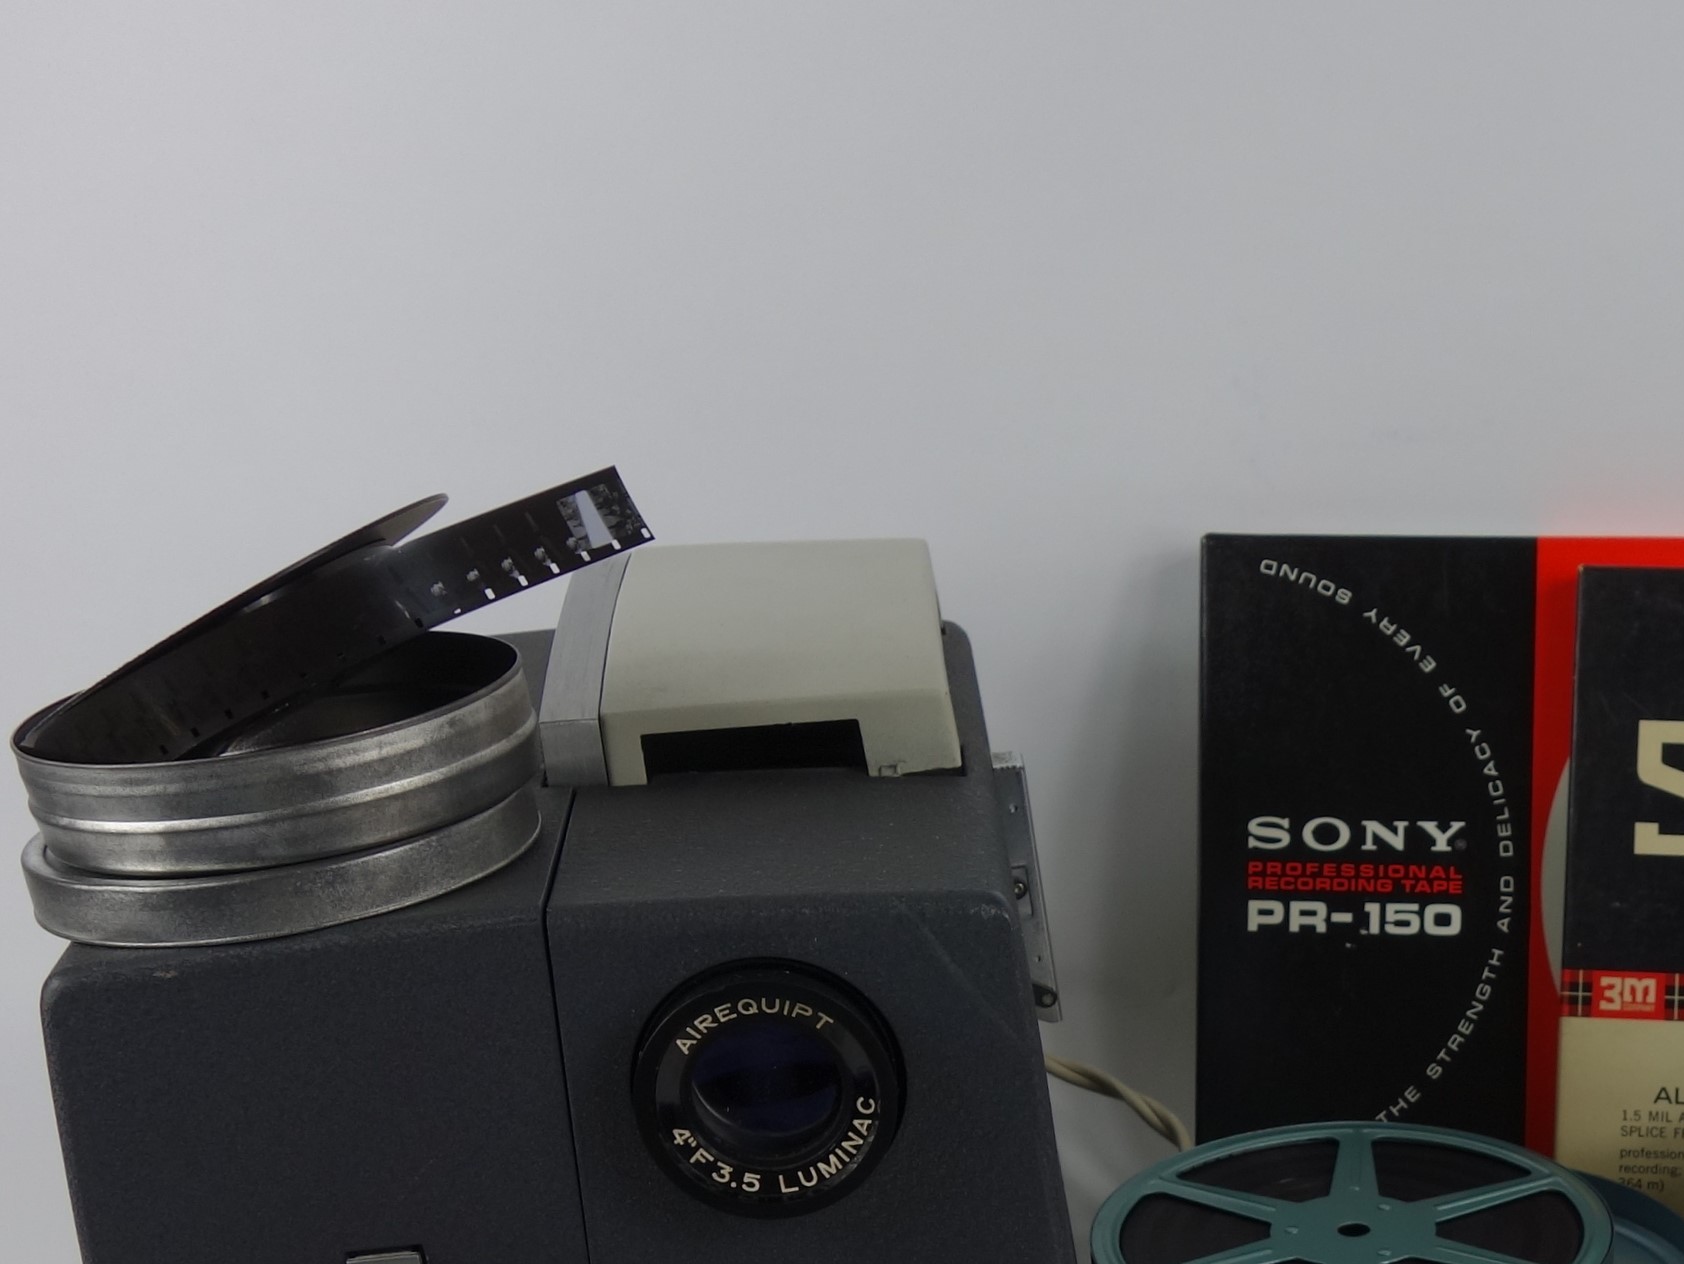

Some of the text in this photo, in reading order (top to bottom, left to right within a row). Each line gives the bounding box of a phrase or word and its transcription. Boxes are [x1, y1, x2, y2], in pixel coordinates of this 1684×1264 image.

[1247, 816, 1467, 852] SONY
[1260, 559, 1514, 1122] THE STRENGTH AND DELICACY OF EVERY SOUND
[1247, 862, 1463, 879] PROFESSIONAL
[1247, 877, 1463, 895] RECORDING TAPE
[1247, 899, 1463, 936] PR-150
[1599, 976, 1657, 1011] 3M
[675, 997, 834, 1055] AIREQUIPT
[779, 1096, 876, 1195] LUMINAC
[1620, 1126, 1667, 1138] SPLICE
